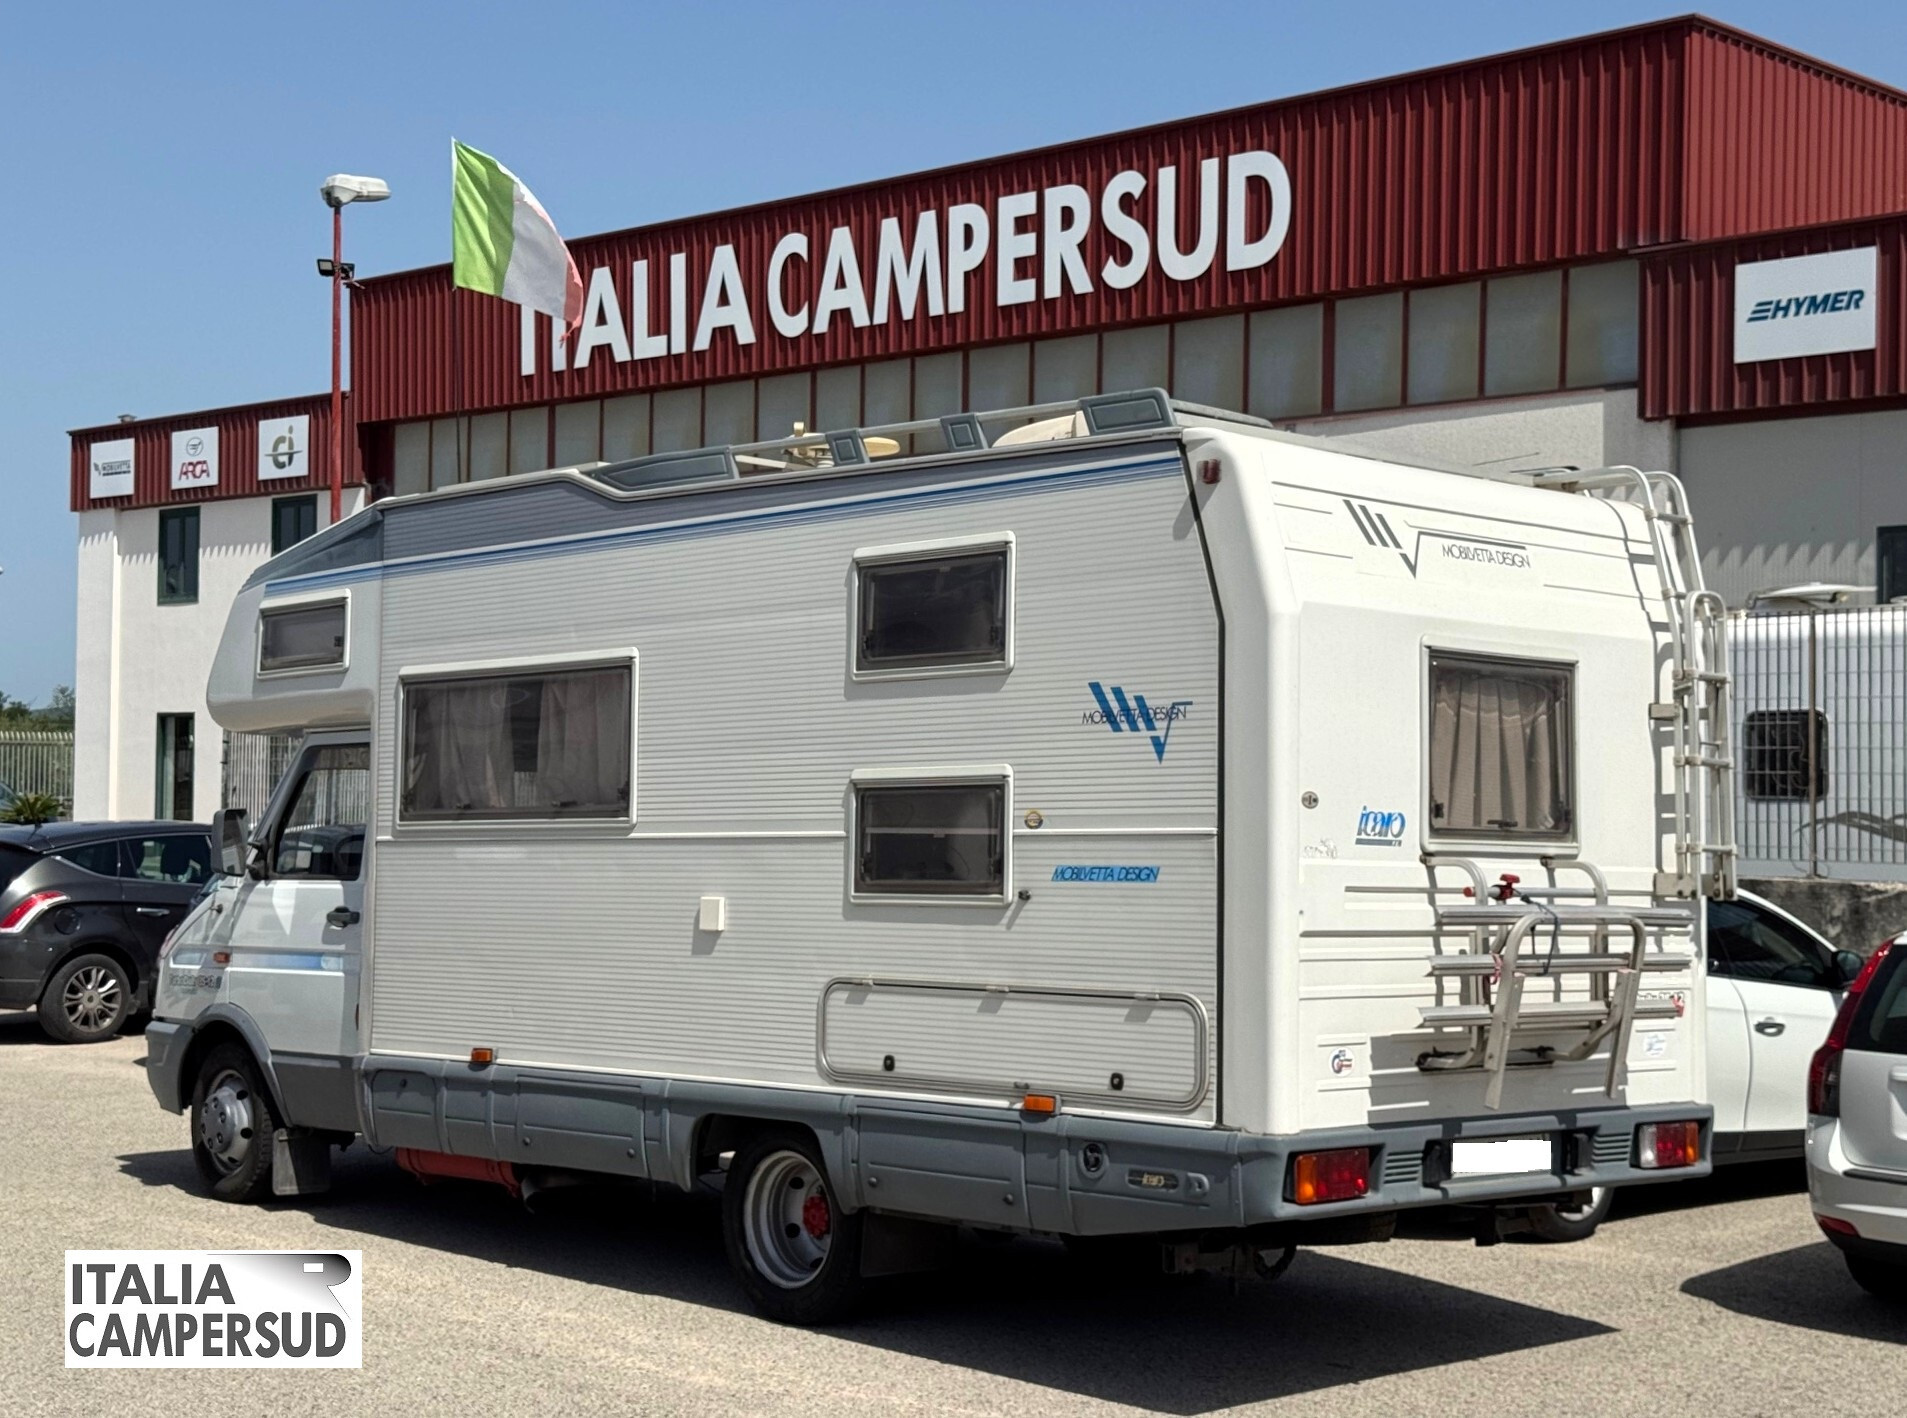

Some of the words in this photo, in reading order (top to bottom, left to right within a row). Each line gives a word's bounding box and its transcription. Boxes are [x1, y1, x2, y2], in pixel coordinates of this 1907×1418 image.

[768, 150, 1292, 339] CAMPERSUD
[1769, 289, 1865, 320] HYMER
[179, 460, 210, 480] ARCA
[1442, 544, 1496, 564] MOBILVETTA
[1495, 550, 1531, 568] DESIGN
[1082, 708, 1146, 724] MOBILVETTA
[1146, 705, 1187, 721] DESIGN
[1051, 866, 1115, 881] MOBILVETTA
[1117, 866, 1159, 881] DESIGN
